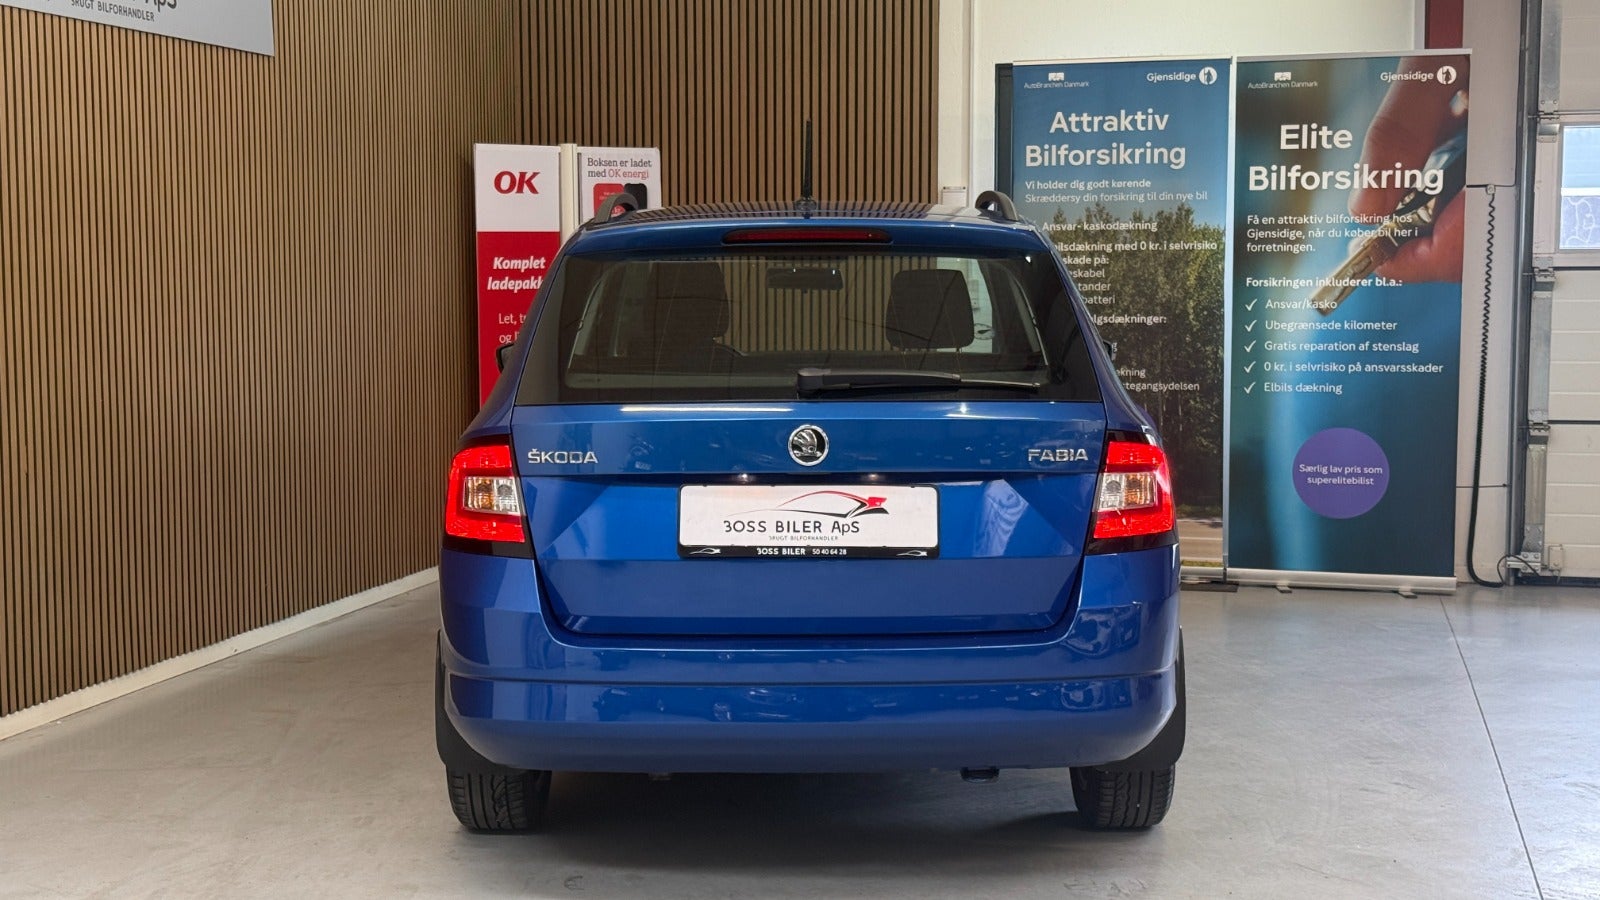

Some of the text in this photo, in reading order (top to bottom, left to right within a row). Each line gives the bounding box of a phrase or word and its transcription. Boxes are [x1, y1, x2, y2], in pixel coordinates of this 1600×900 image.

[97, 3, 155, 21] BILFORHANDLER
[1146, 72, 1197, 84] Gjensidige
[1380, 70, 1434, 83] Gjensidige
[1049, 108, 1170, 133] Attraktiv
[1280, 123, 1353, 150] Elite
[1025, 142, 1186, 170] Bilforsikring
[587, 157, 652, 168] Boksen er ladet
[588, 169, 649, 180] med OK energi
[1249, 162, 1444, 195] Bilforsikring
[493, 170, 541, 195] OK
[1025, 179, 1151, 191] Vi holder dig godt kørende
[1025, 192, 1207, 204] Skræddersy din forsikring til din nye bil
[1247, 214, 1412, 226] Få en attraktiv bilforsikring hos
[1084, 221, 1158, 232] kaskodækning
[1247, 228, 1305, 239] Gjensidige,
[1308, 228, 1326, 238] når
[1328, 228, 1342, 237] du
[1344, 228, 1375, 238] køber
[1377, 227, 1391, 237] bil
[1394, 227, 1412, 237] her
[1114, 241, 1138, 251] med
[1140, 241, 1147, 250] 0
[1149, 241, 1162, 250] kr.
[1169, 241, 1217, 251] selvrisiko
[1247, 242, 1316, 253] forretningen.
[493, 256, 546, 273] Komplet
[1063, 255, 1110, 267] skade på:
[1246, 277, 1313, 289] Forsikringen
[1316, 278, 1372, 287] inkluderer
[1265, 298, 1338, 310] Ansvar/kasko
[498, 313, 517, 325] Let,
[1265, 320, 1398, 332] Ubegrænsede kilometer
[499, 334, 512, 344] og
[1264, 341, 1419, 353] Gratis reparation af stenslag
[1264, 362, 1272, 372] 0
[1274, 362, 1287, 372] kr.
[1295, 362, 1346, 373] selvrisiko
[1348, 362, 1362, 375] på
[1364, 363, 1443, 373] ansvarsskader
[1123, 382, 1200, 392] tegangsydelsen
[1264, 382, 1343, 395] Elbils dækning
[527, 448, 599, 464] ŠKODA
[1028, 448, 1089, 462] FABIA
[1299, 464, 1383, 475] Særlig lav pris som
[1307, 476, 1375, 486] superelitebilist
[776, 520, 822, 533] BILER
[831, 520, 860, 536] ApS
